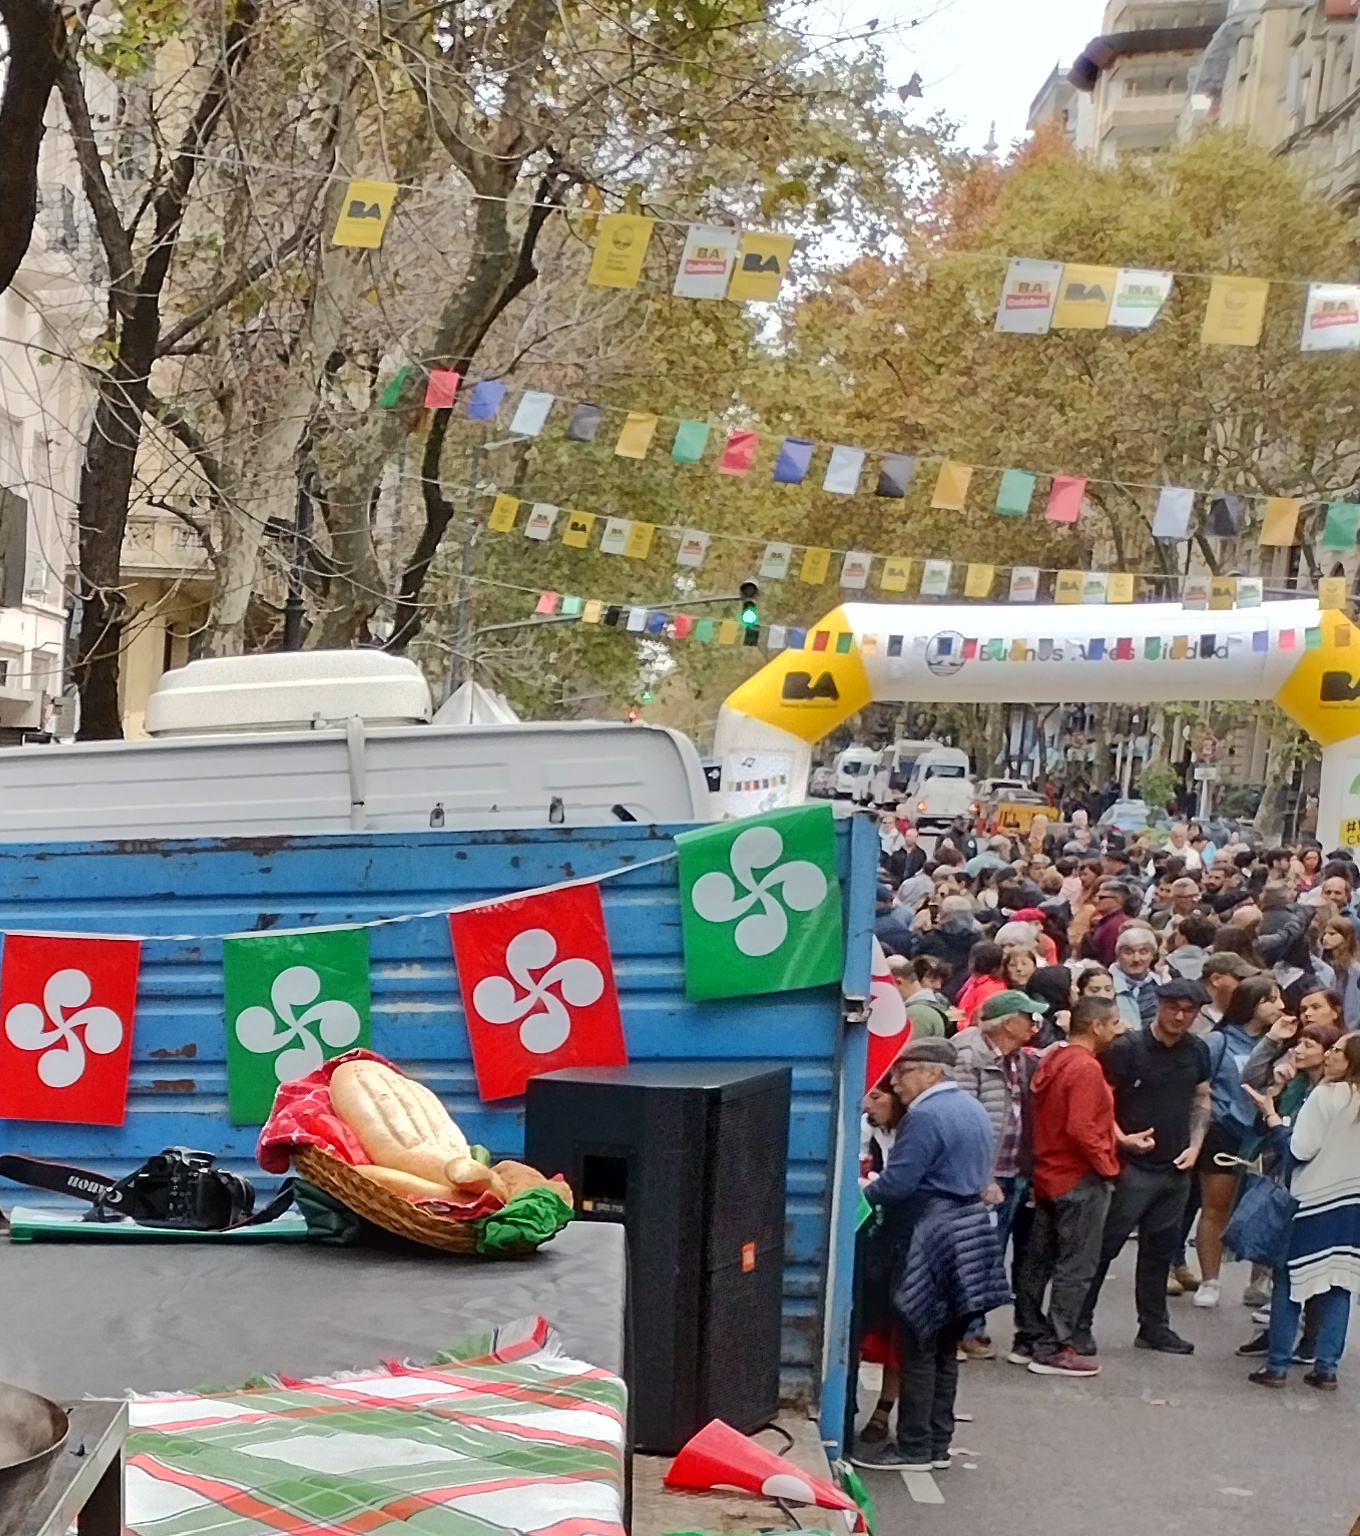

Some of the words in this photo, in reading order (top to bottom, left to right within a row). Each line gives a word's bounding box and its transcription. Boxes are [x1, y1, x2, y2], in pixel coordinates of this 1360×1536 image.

[347, 200, 381, 220] BA
[696, 246, 721, 259] BA
[742, 253, 780, 275] BA
[1018, 282, 1043, 293] BA
[1064, 283, 1106, 302] BA
[1322, 301, 1349, 312] BA
[980, 645, 1064, 661] Buns
[782, 671, 839, 701] BA
[1320, 671, 1360, 701] B
